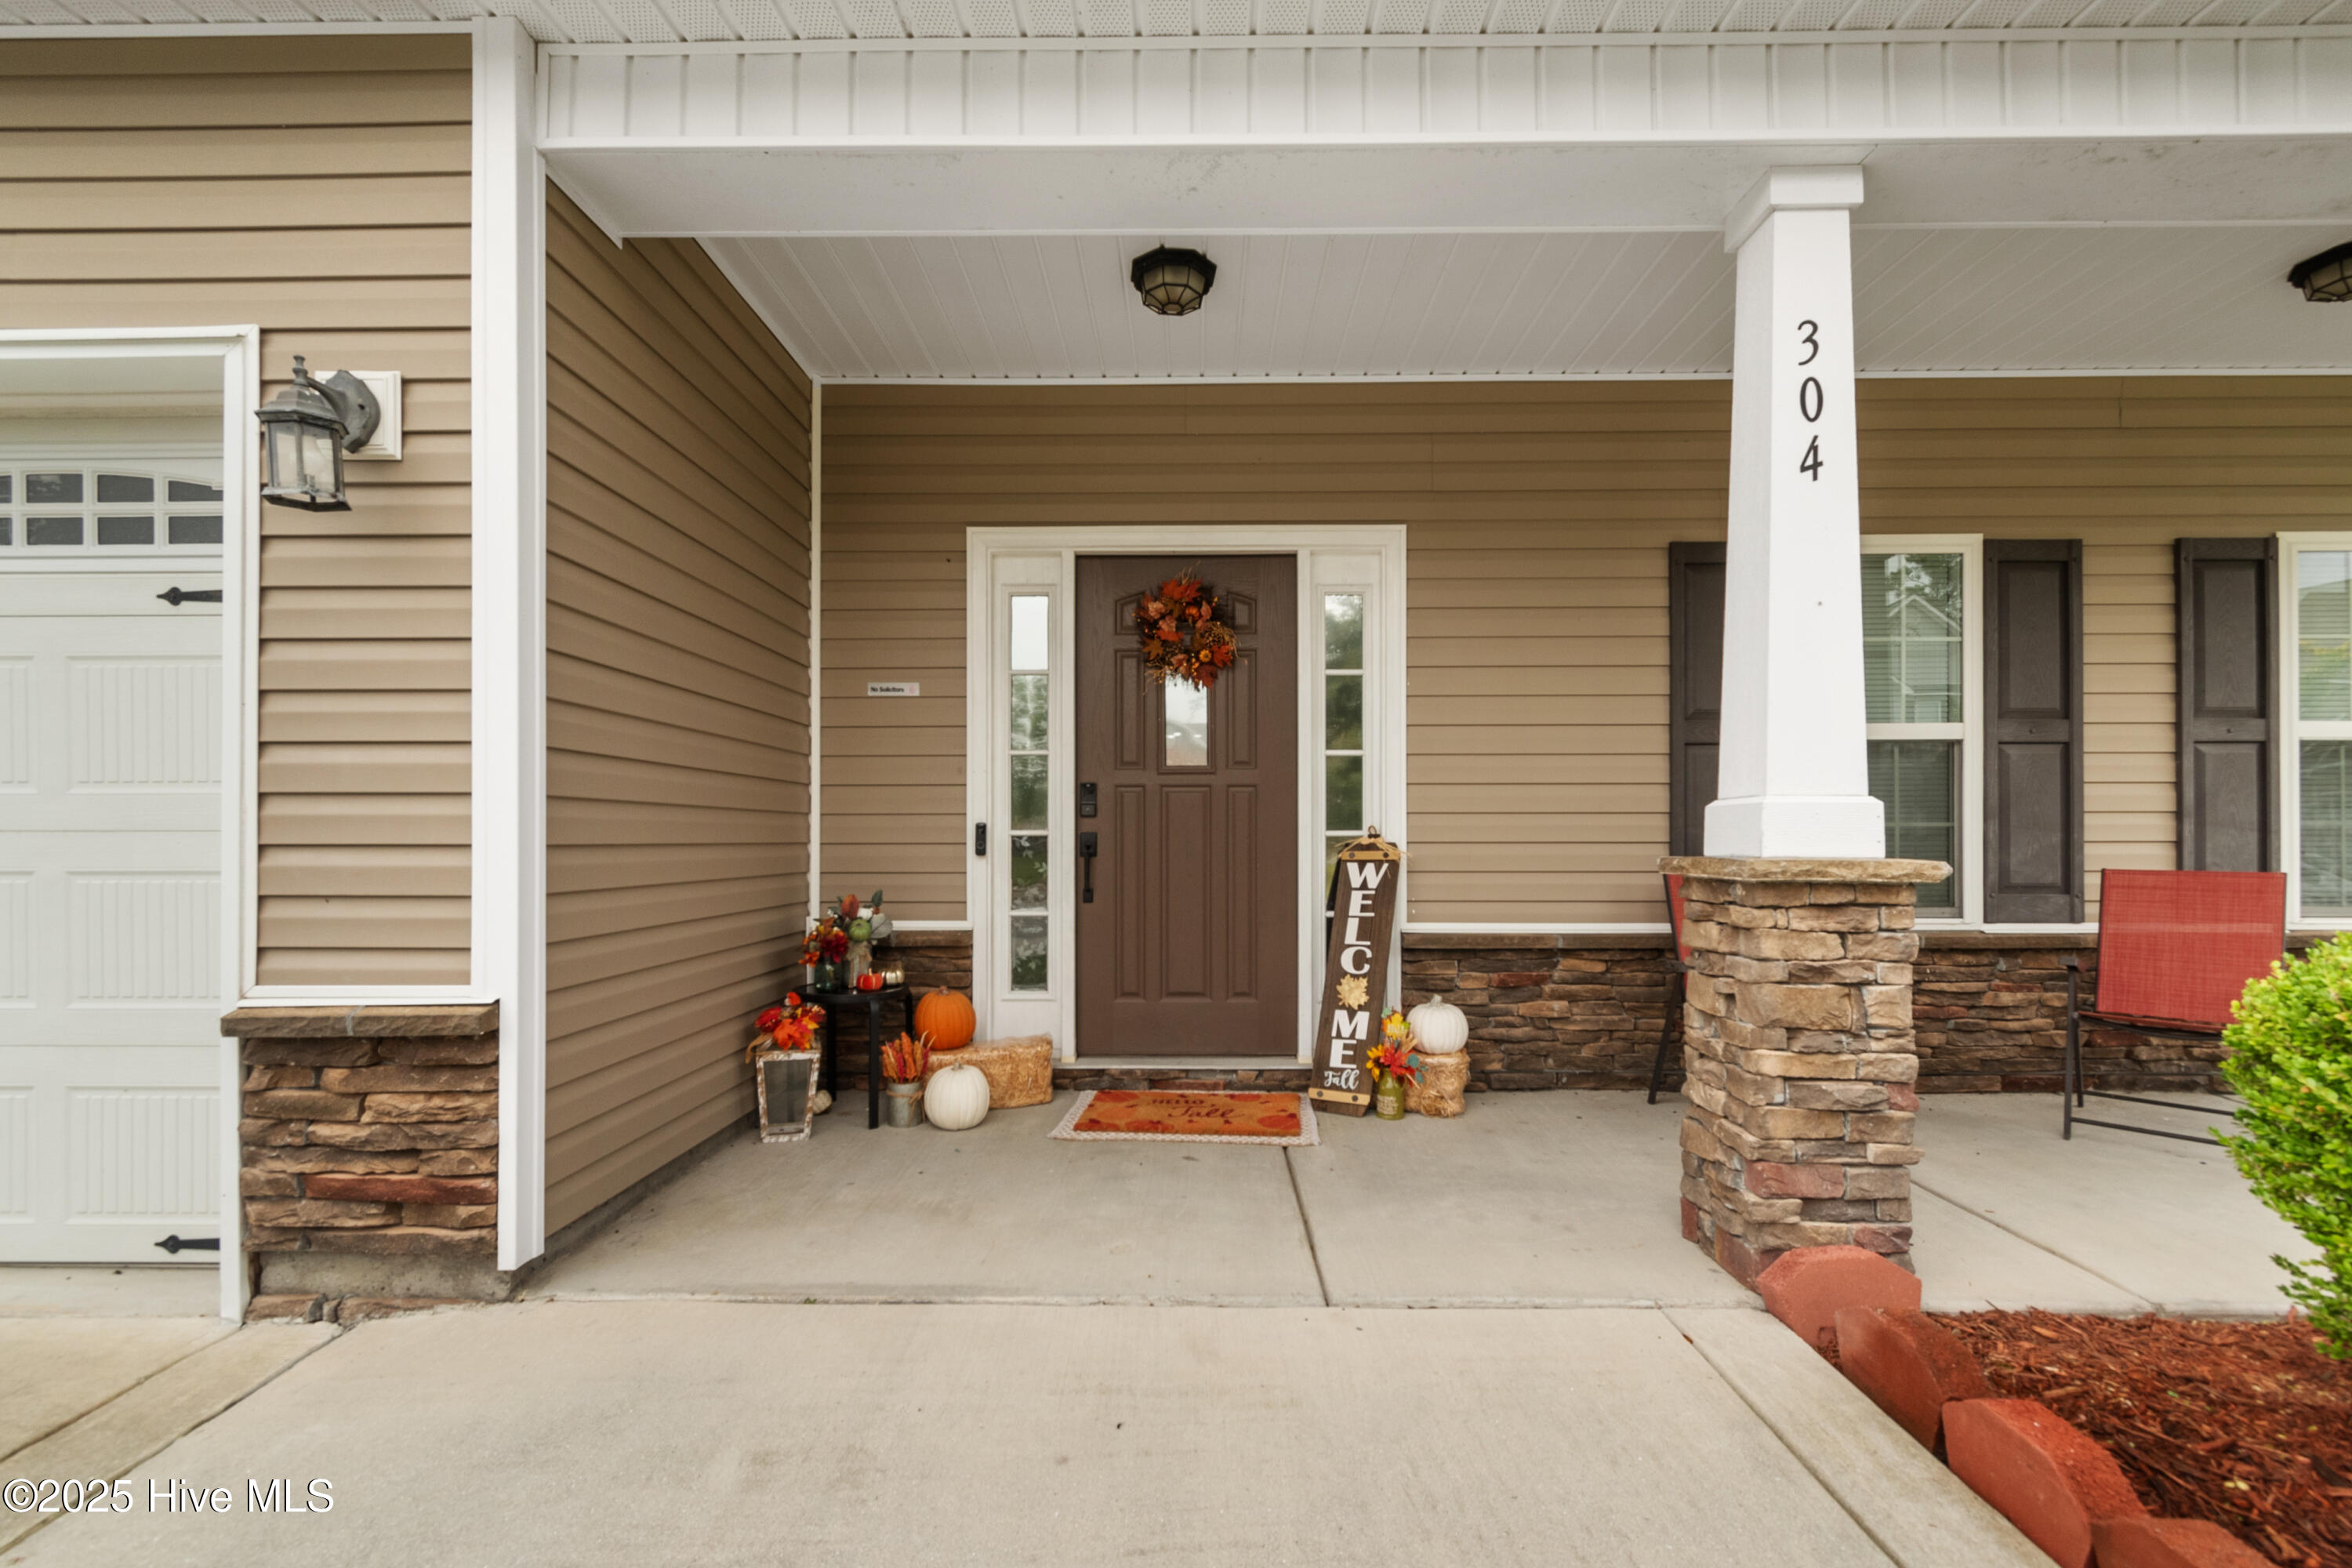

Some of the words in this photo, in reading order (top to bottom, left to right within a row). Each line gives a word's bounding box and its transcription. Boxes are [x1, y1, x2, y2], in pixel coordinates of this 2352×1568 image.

[1797, 319, 1824, 481] 304
[1329, 862, 1389, 1069] WELCME
[1323, 1069, 1360, 1091] Fall
